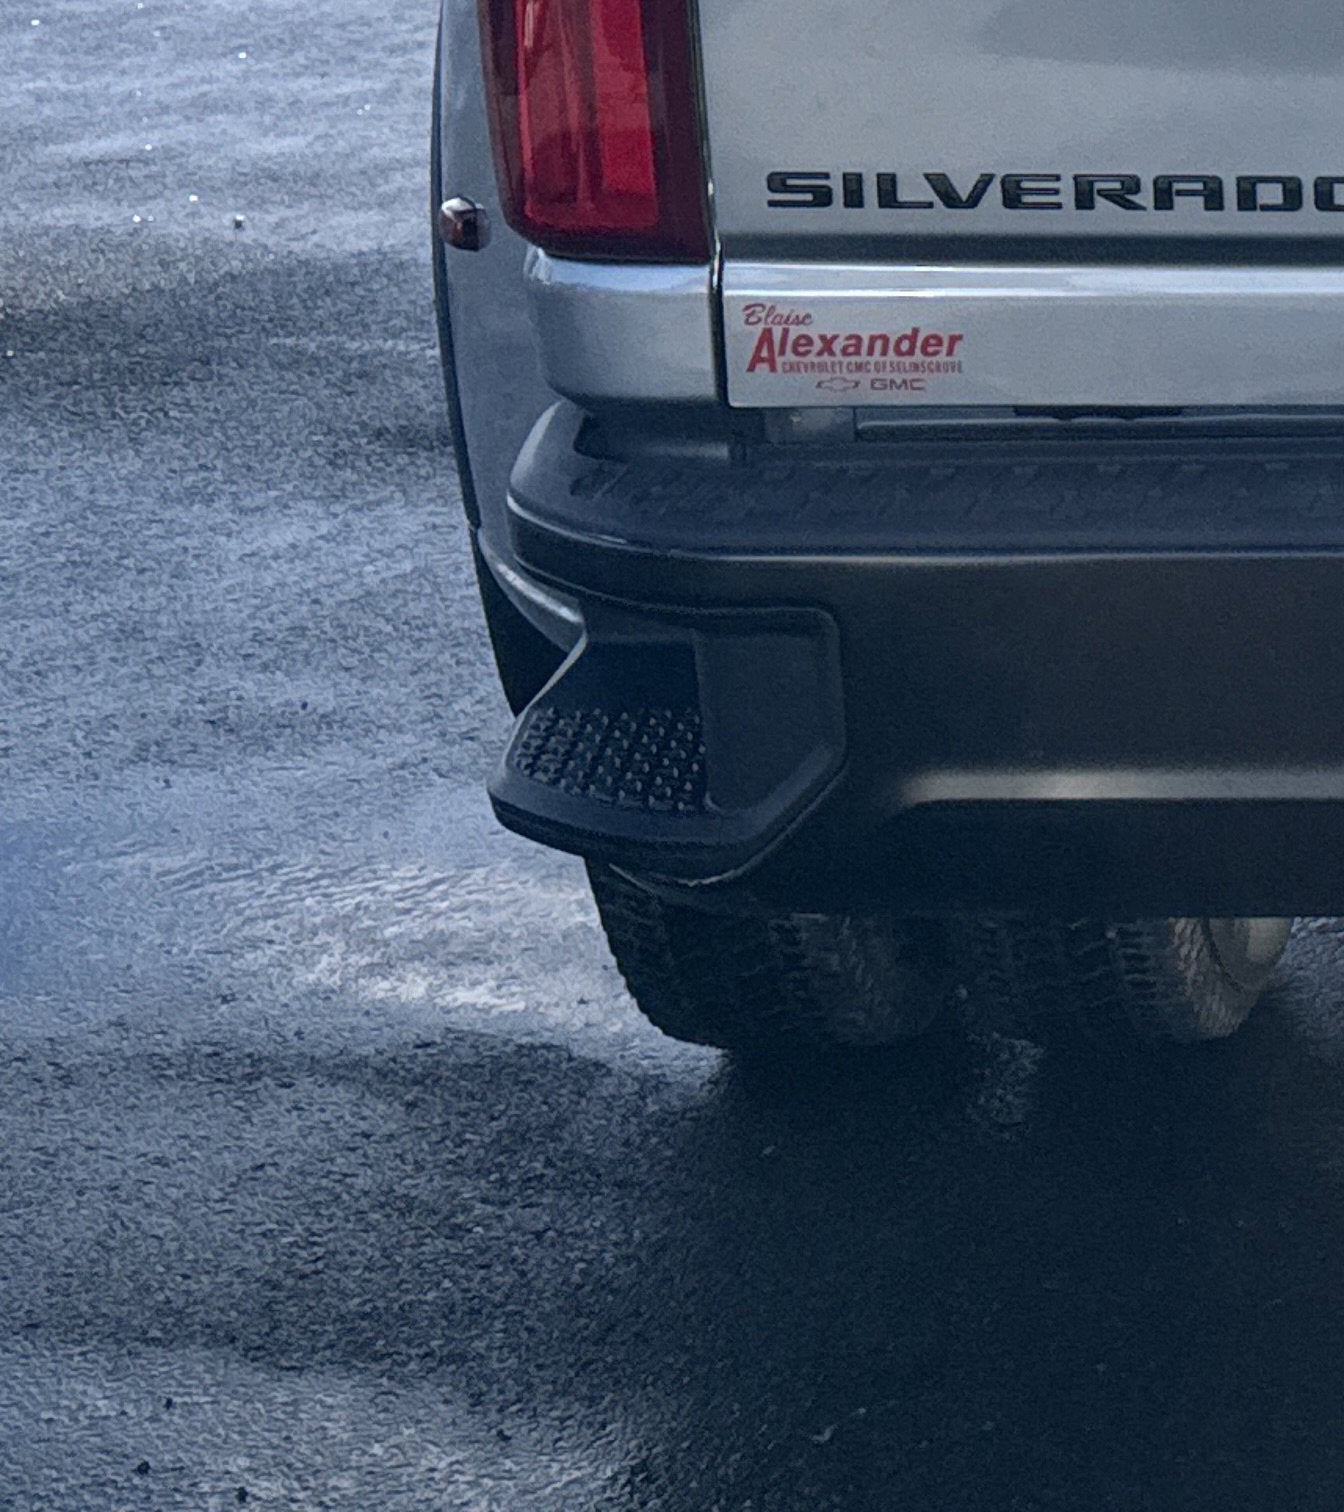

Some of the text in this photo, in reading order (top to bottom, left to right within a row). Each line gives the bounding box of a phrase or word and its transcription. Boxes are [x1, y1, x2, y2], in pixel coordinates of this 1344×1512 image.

[742, 303, 813, 326] Blaise
[746, 326, 964, 373] Alexander
[870, 378, 926, 391] GMC
